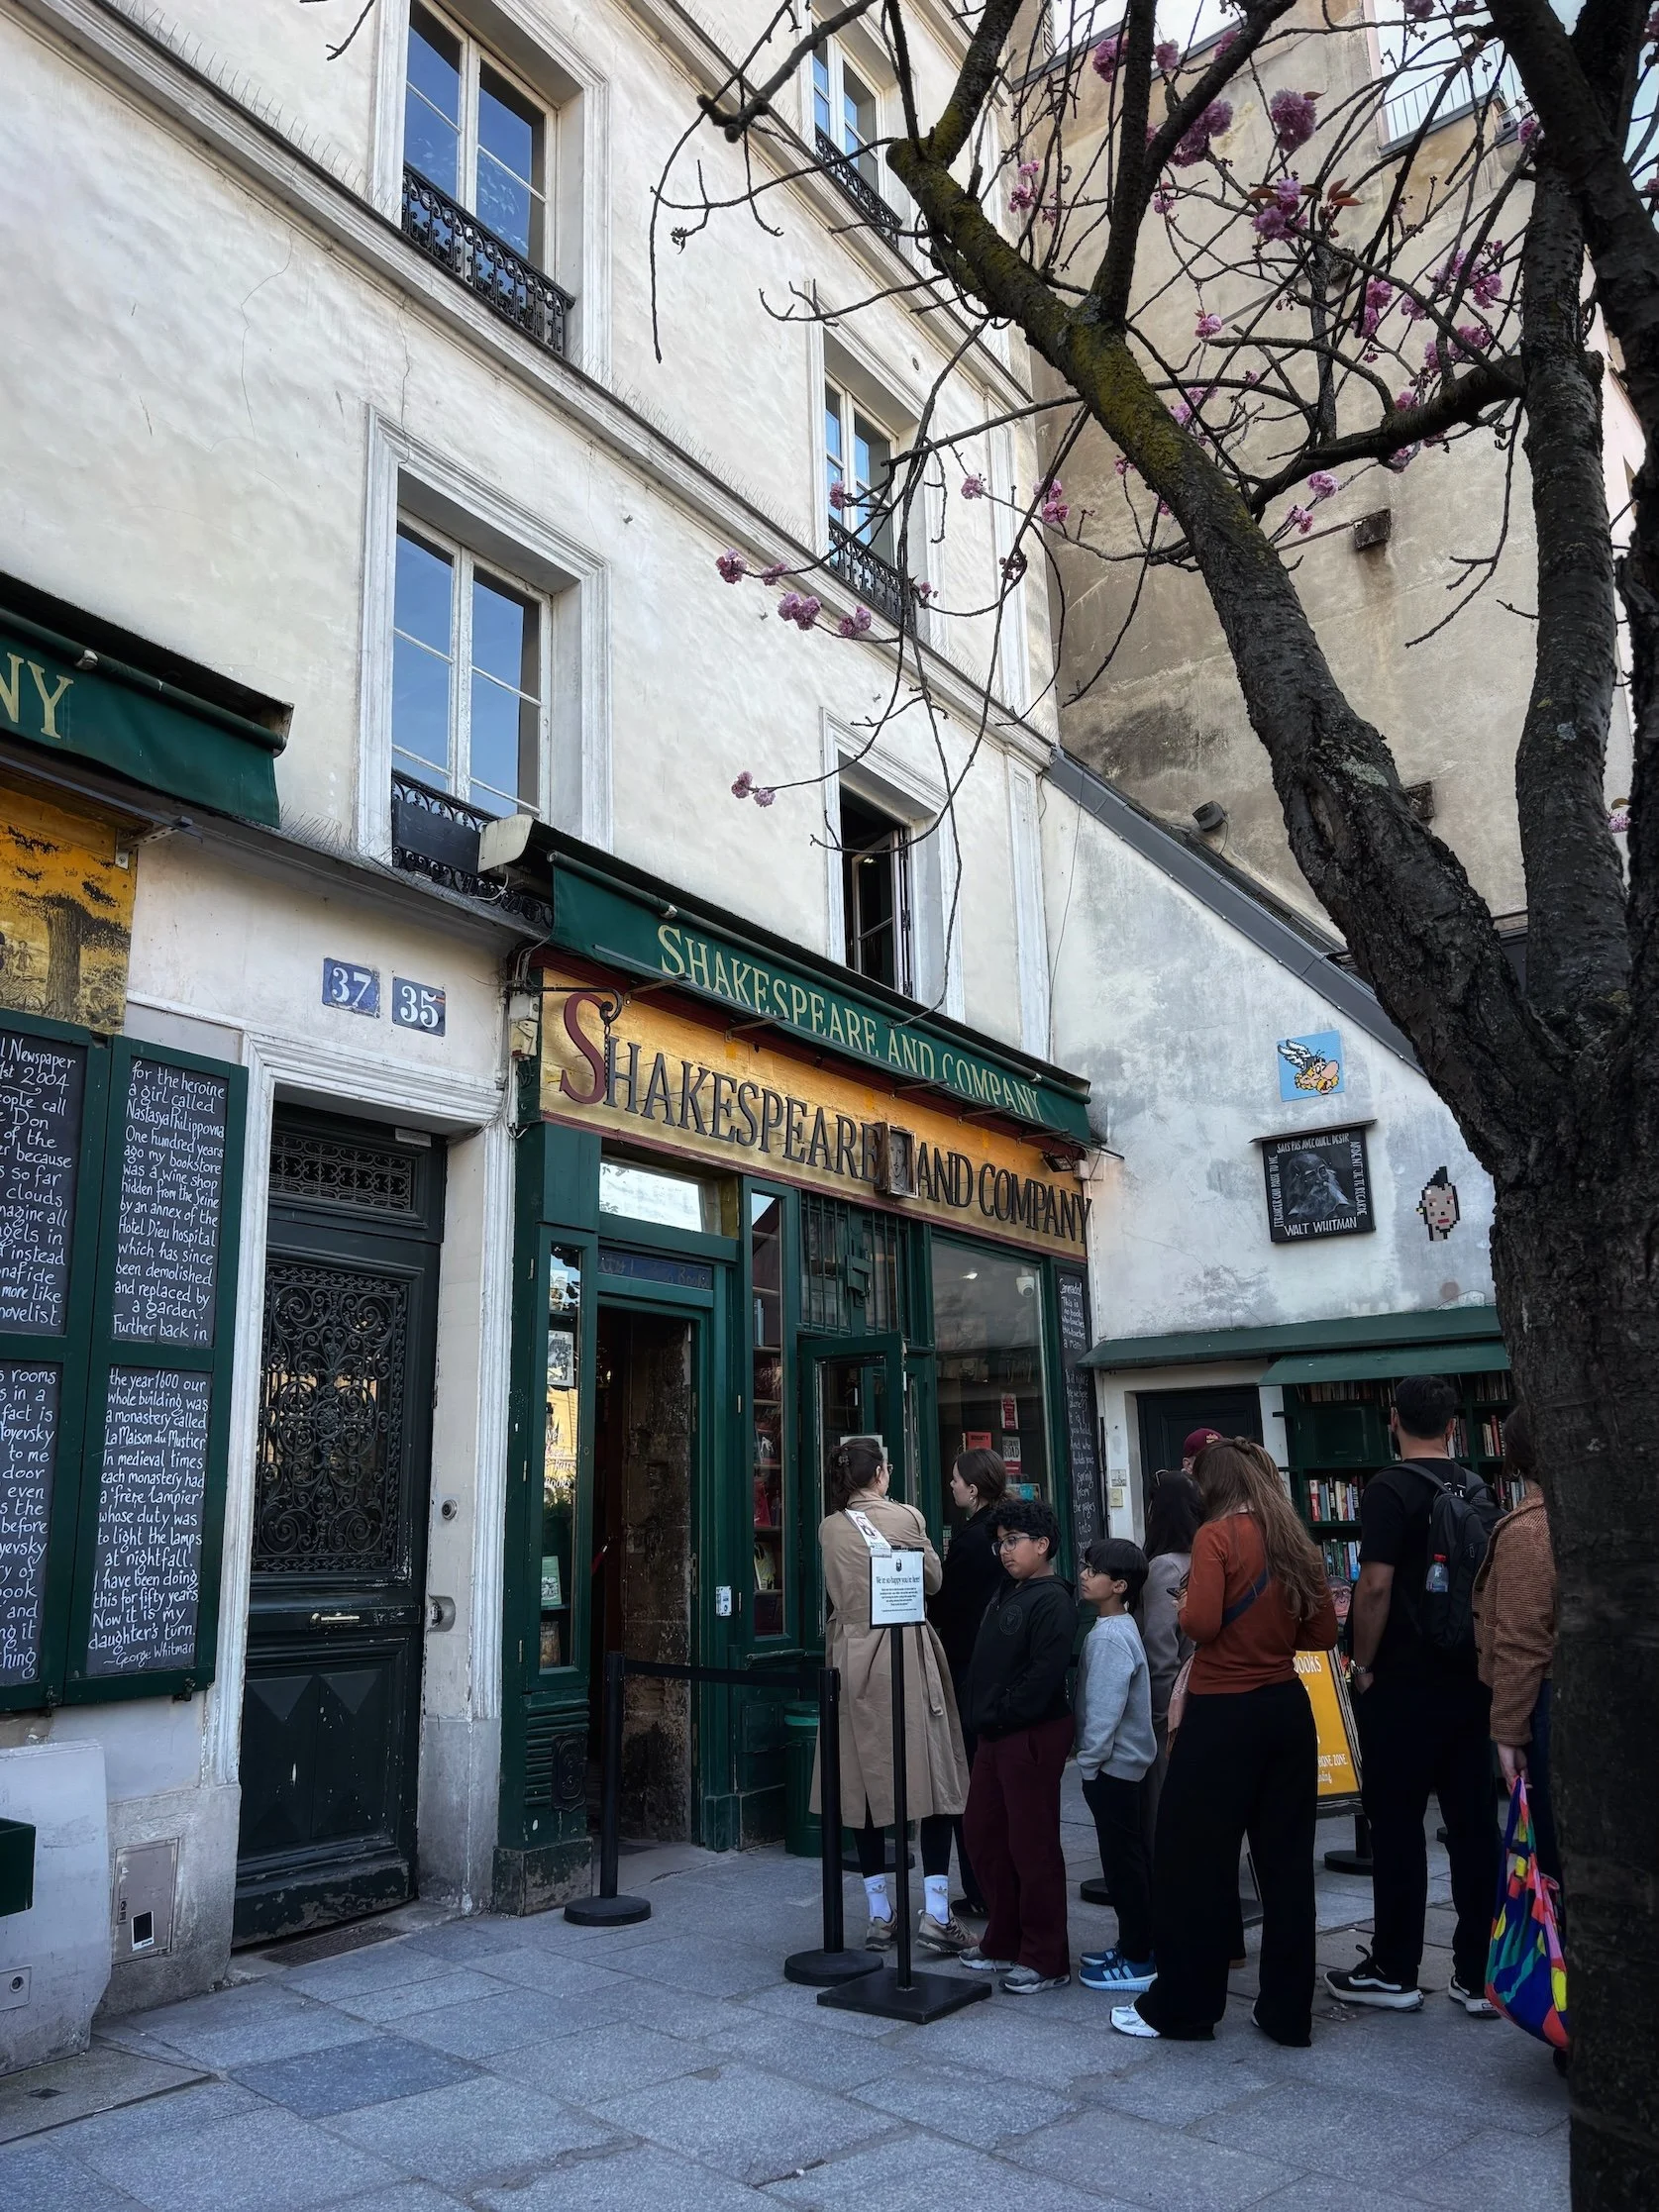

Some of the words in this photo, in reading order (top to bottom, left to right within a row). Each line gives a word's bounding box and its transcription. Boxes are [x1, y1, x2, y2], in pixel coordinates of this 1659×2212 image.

[332, 967, 371, 1008] 37
[400, 985, 440, 1028] 35
[657, 924, 878, 1057] SHAKESPEARE
[887, 1031, 936, 1078] AND
[942, 1052, 1046, 1124] COMPANY
[9, 1038, 76, 1074] Newspaper
[21, 1066, 69, 1094] 2004
[133, 1060, 153, 1081] for
[157, 1066, 179, 1089] the
[181, 1071, 225, 1099] heroine
[42, 1097, 67, 1117] call
[129, 1083, 137, 1096] a
[141, 1085, 168, 1107] girl
[171, 1093, 215, 1114] called
[12, 1107, 49, 1130] Don
[126, 1098, 169, 1131] Nastasya
[560, 992, 882, 1185] SHAKESPEARE
[917, 1141, 975, 1208] AND
[979, 1162, 1092, 1245] COMPANY
[4, 1125, 20, 1147] of
[27, 1128, 57, 1149] the
[126, 1125, 149, 1144] One
[152, 1129, 196, 1154] hundred
[197, 1143, 224, 1161] years
[16, 1142, 72, 1168] because
[124, 1145, 145, 1164] ago
[149, 1150, 165, 1168] my
[170, 1150, 222, 1175] bookstore
[11, 1166, 31, 1180] so
[34, 1164, 62, 1188] far
[123, 1163, 146, 1177] was
[149, 1166, 157, 1179] a
[162, 1168, 188, 1185] wine
[190, 1172, 218, 1197] shop
[6, 1183, 63, 1207] clouds
[121, 1175, 153, 1196] hidden
[156, 1178, 177, 1204] from
[178, 1183, 193, 1203] the
[193, 1188, 220, 1209] Seine
[47, 1208, 68, 1228] all
[120, 1194, 133, 1218] by
[134, 1201, 148, 1214] an
[151, 1202, 182, 1220] annex
[184, 1205, 198, 1227] of
[199, 1209, 218, 1228] the
[48, 1228, 63, 1246] in
[119, 1215, 146, 1236] Hotel
[147, 1218, 169, 1239] Dieu
[172, 1220, 215, 1248] hospital
[1284, 1223, 1309, 1236] WALT
[1312, 1217, 1358, 1234] WHITMAN
[11, 1245, 65, 1266] instead
[118, 1236, 155, 1258] which
[158, 1241, 178, 1262] has
[182, 1249, 214, 1266] since
[116, 1256, 142, 1276] been
[146, 1261, 213, 1287] demolished
[1, 1285, 29, 1300] more
[114, 1278, 136, 1295] and
[139, 1279, 192, 1303] replaced
[196, 1287, 211, 1312] by
[132, 1299, 141, 1313] a
[146, 1298, 204, 1320] garden.
[114, 1313, 156, 1337] Further
[159, 1317, 189, 1339] back
[194, 1323, 208, 1341] in
[12, 1368, 56, 1385] rooms
[109, 1367, 129, 1386] the
[130, 1374, 155, 1392] year
[155, 1369, 180, 1389] 1600
[183, 1380, 207, 1393] our
[14, 1384, 27, 1402] in
[35, 1388, 46, 1402] a
[108, 1386, 137, 1407] whole
[139, 1389, 183, 1417] building
[186, 1398, 208, 1413] was
[2, 1403, 33, 1427] fact
[40, 1406, 53, 1423] is
[106, 1409, 113, 1423] a
[115, 1407, 171, 1434] monastery
[173, 1412, 206, 1430] called
[119, 1425, 153, 1447] Maison
[154, 1431, 166, 1445] du
[9, 1443, 24, 1462] to
[28, 1451, 51, 1463] me
[103, 1449, 115, 1466] In
[118, 1449, 165, 1467] medieval
[170, 1449, 203, 1470] times
[2, 1463, 46, 1480] door
[101, 1466, 125, 1484] each
[128, 1467, 182, 1493] monastery
[184, 1469, 205, 1489] had
[7, 1486, 45, 1500] even
[100, 1489, 107, 1504] a
[15, 1498, 45, 1516] the
[98, 1504, 134, 1525] whose
[137, 1504, 170, 1533] duty
[174, 1513, 198, 1527] was
[1, 1515, 49, 1540] before
[97, 1527, 110, 1546] to
[113, 1525, 144, 1554] light
[149, 1526, 167, 1545] the
[170, 1526, 202, 1555] lamps
[19, 1556, 37, 1582] of
[104, 1548, 121, 1566] at
[93, 1569, 98, 1592] I
[102, 1567, 131, 1589] have
[134, 1568, 159, 1587] been
[162, 1567, 199, 1590] doing
[7, 1599, 39, 1620] and
[93, 1590, 119, 1609] this
[121, 1587, 139, 1613] for
[139, 1586, 166, 1613] fifty
[22, 1619, 37, 1641] it
[92, 1608, 122, 1630] Now
[126, 1604, 138, 1624] it
[143, 1605, 156, 1622] is
[162, 1607, 187, 1629] my
[87, 1622, 158, 1655] daughter's
[154, 1640, 195, 1659] Whitman
